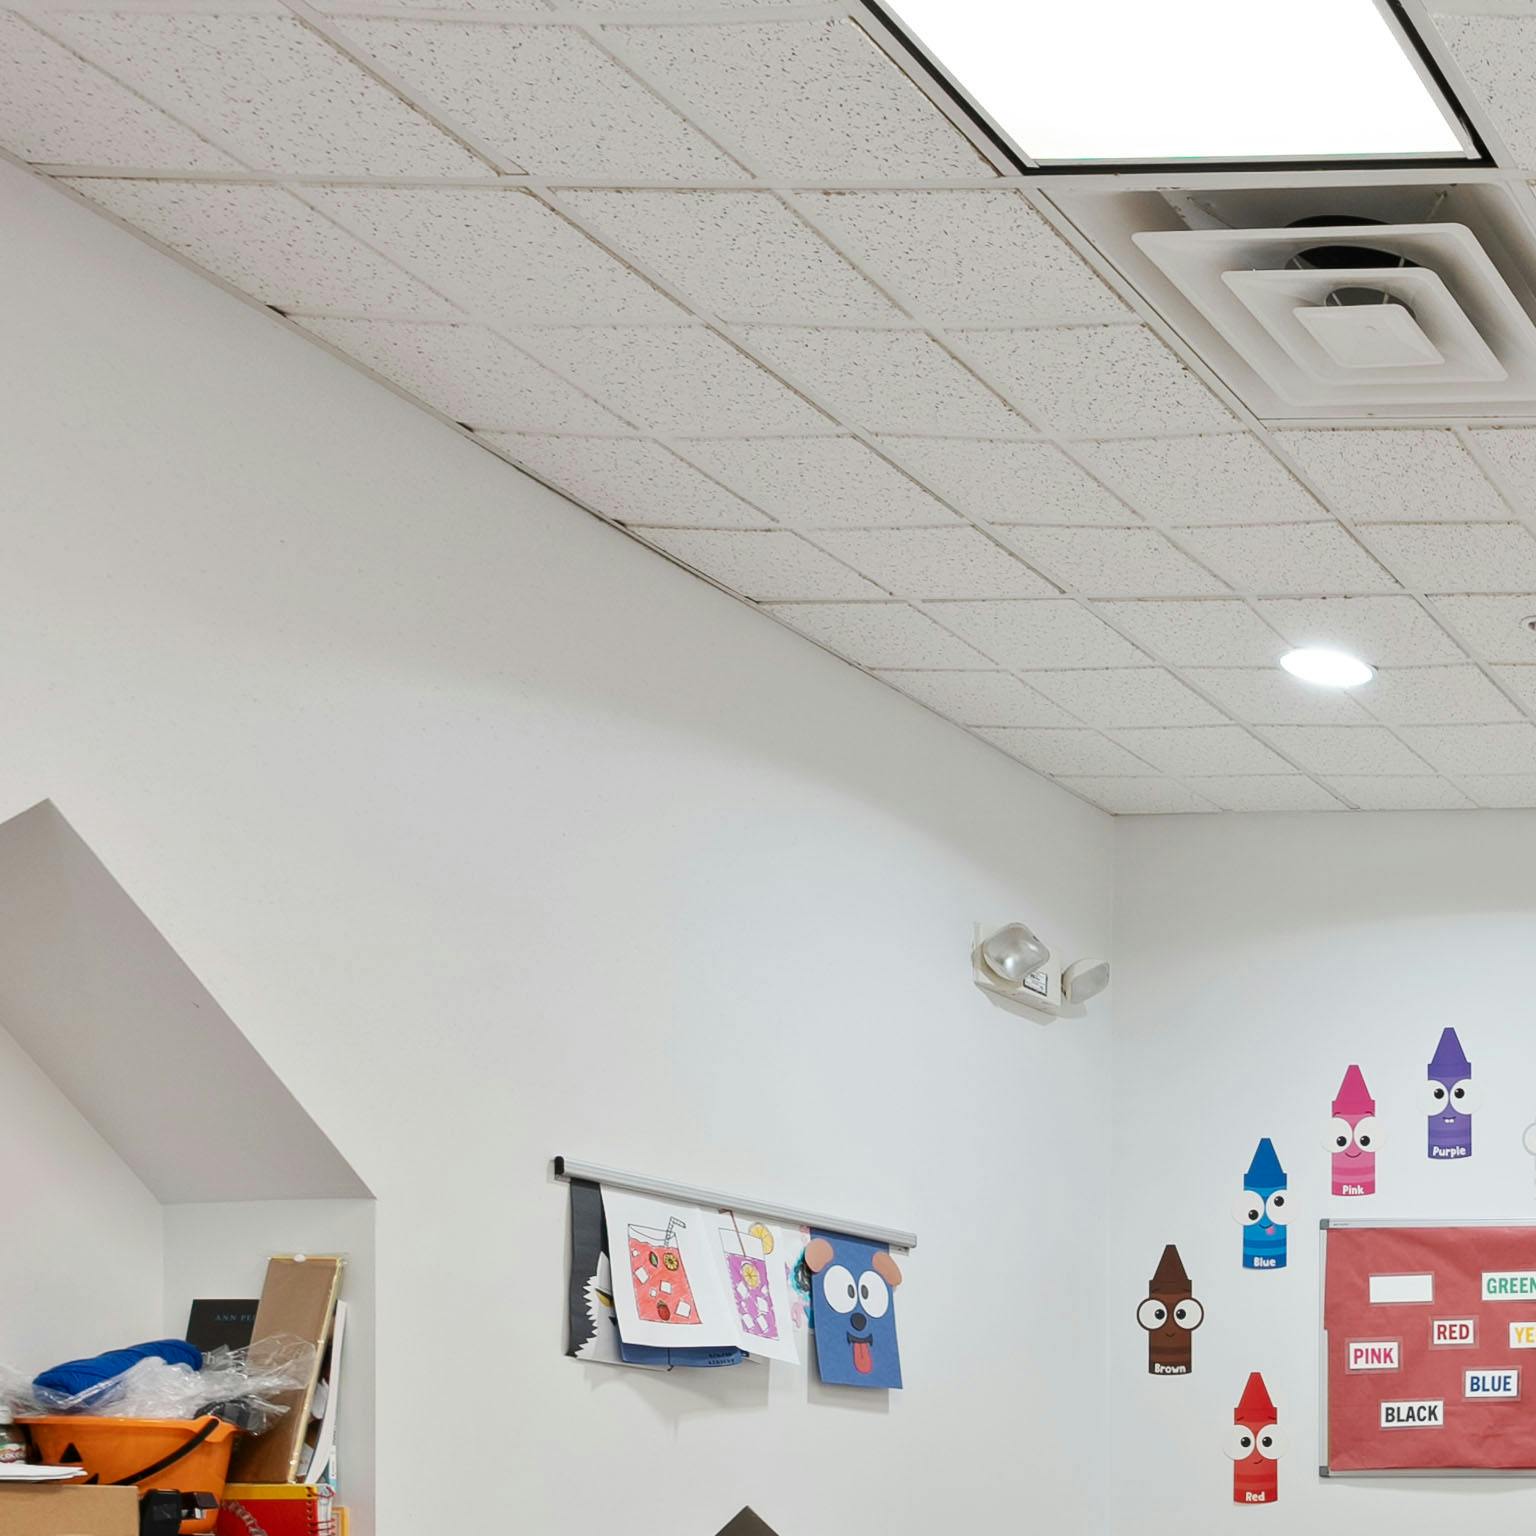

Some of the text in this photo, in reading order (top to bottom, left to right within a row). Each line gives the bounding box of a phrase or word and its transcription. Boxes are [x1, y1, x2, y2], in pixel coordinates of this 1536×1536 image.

[1432, 1145, 1466, 1158] Purple
[1342, 1184, 1365, 1195] Pink
[1253, 1256, 1277, 1268] Blue
[1436, 1323, 1471, 1341] RED
[1353, 1347, 1395, 1366] PINK
[1154, 1363, 1187, 1374] Brown
[1469, 1374, 1513, 1393] BLUE
[1384, 1405, 1439, 1424] BLACK
[1245, 1491, 1266, 1502] Red
